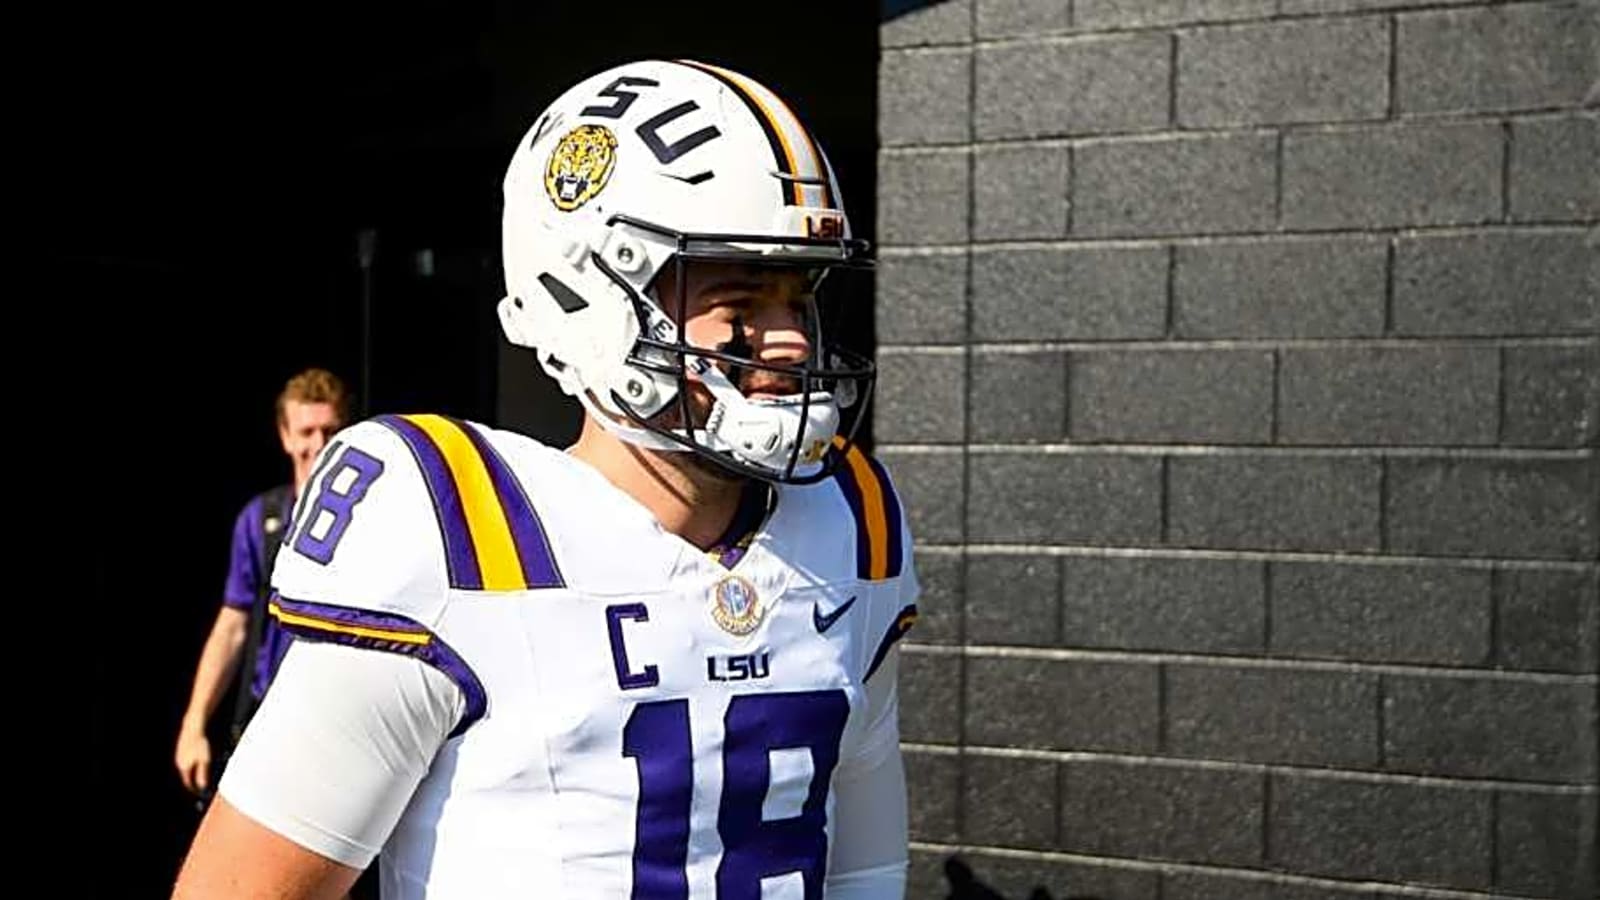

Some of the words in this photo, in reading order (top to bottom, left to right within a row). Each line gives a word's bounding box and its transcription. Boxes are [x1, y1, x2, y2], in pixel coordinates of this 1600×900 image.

[606, 602, 660, 690] C
[707, 652, 769, 681] LSU
[623, 689, 850, 900] 18
